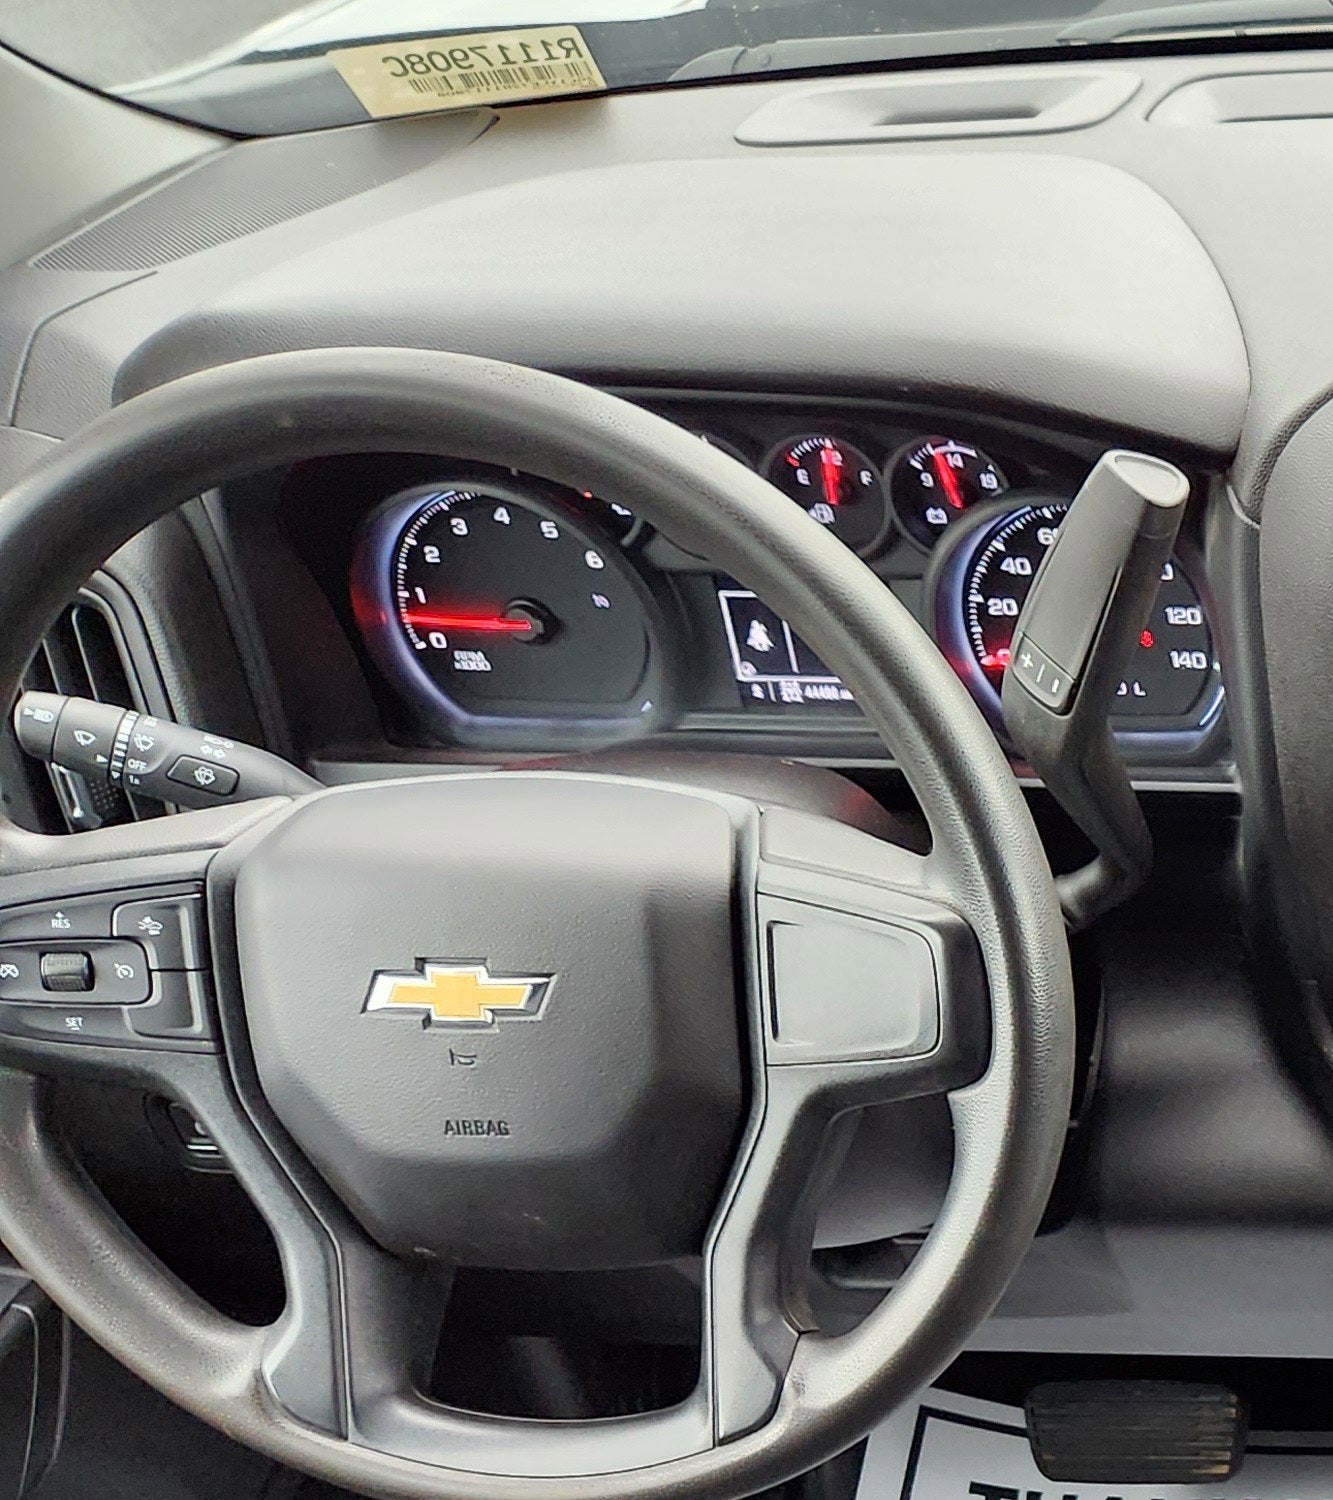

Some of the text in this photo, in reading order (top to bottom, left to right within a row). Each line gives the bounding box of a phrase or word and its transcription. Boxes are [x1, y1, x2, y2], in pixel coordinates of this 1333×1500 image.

[492, 506, 511, 525] 4
[450, 517, 469, 536] 3
[539, 520, 559, 539] 5
[423, 545, 441, 564] 2
[584, 549, 605, 569] 6
[1000, 556, 1032, 576] 40
[414, 586, 427, 604] 1
[987, 597, 1019, 616] 20
[1164, 606, 1202, 625] 120
[428, 632, 448, 650] 0
[1169, 650, 1208, 669] 140
[127, 758, 148, 771] OFF
[51, 918, 71, 929] RES
[65, 1016, 83, 1027] SET
[443, 1119, 510, 1136] AIRBAG
